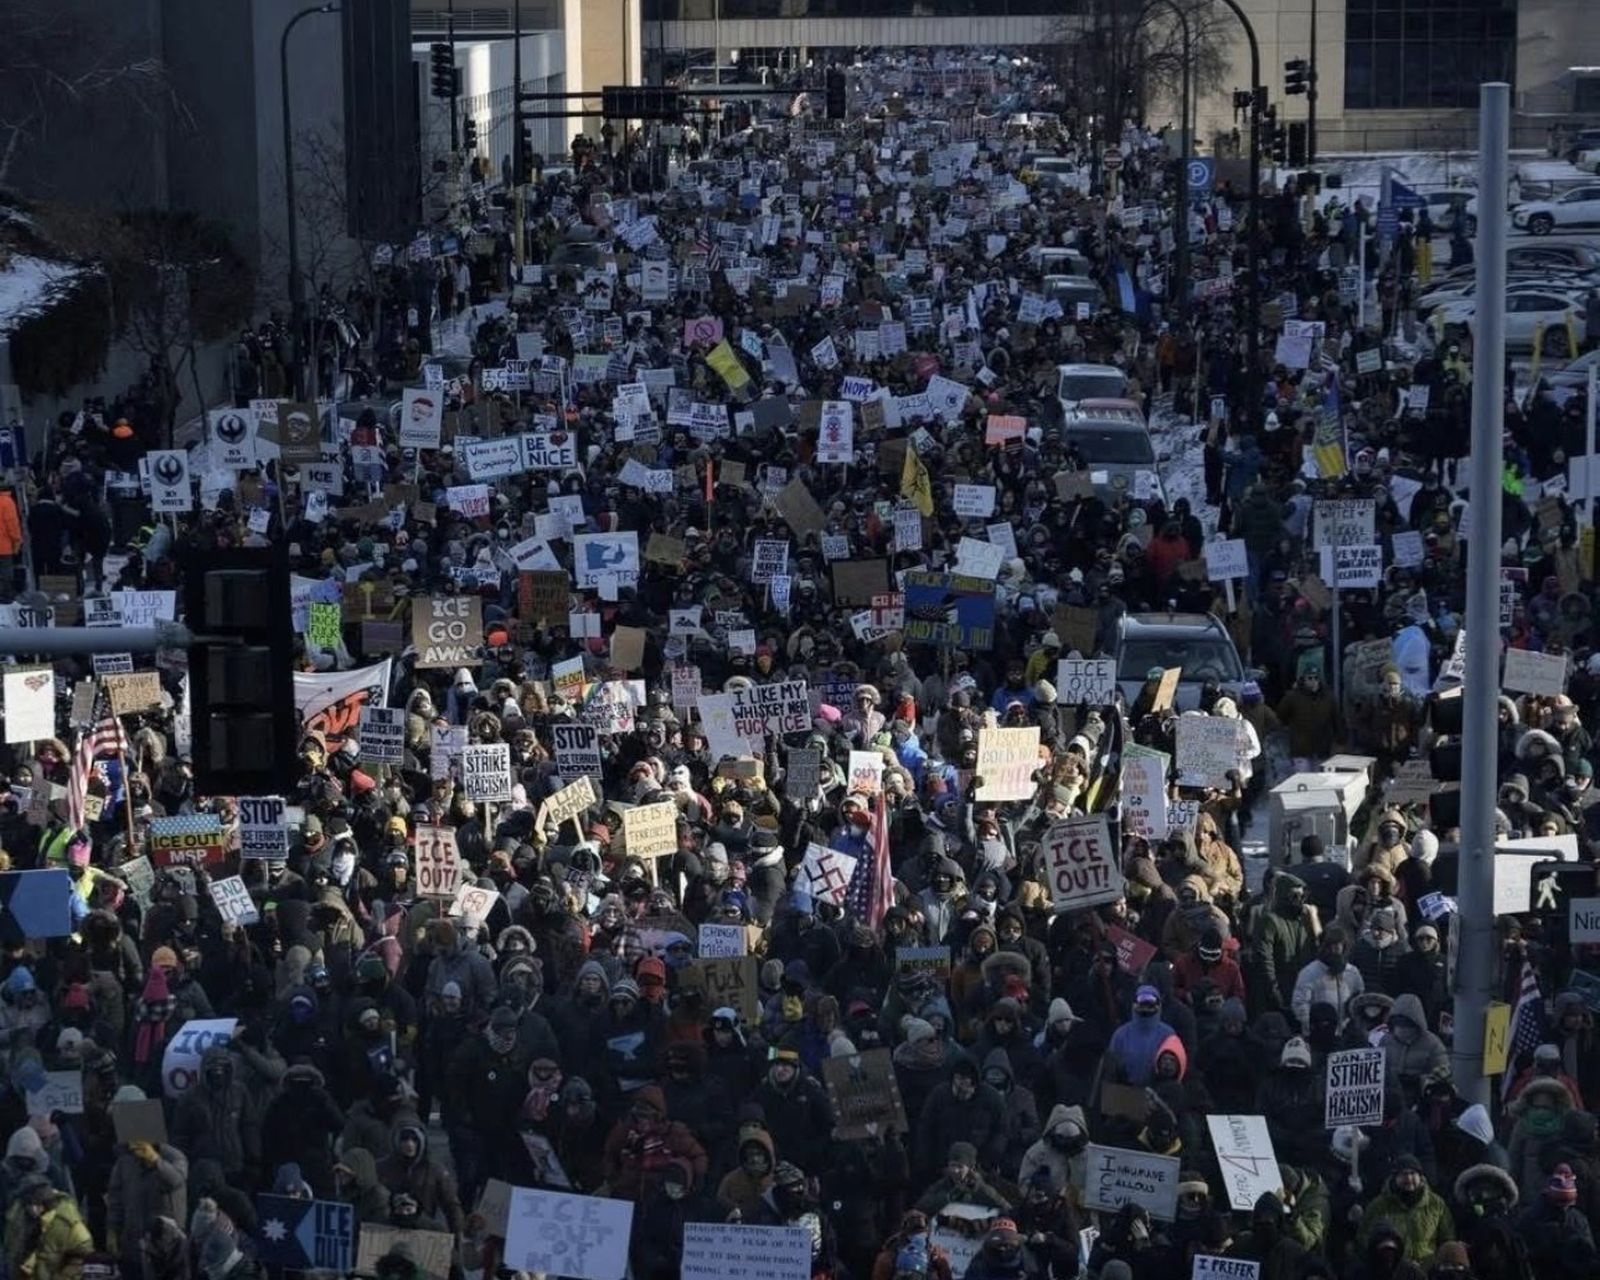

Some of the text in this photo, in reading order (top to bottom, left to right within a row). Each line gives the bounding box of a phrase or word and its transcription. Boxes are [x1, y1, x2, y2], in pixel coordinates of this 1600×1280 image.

[843, 381, 871, 397] NOPE
[526, 438, 543, 450] BE
[530, 450, 573, 466] NICE
[309, 471, 331, 482] ICE
[432, 599, 470, 617] ICE
[429, 620, 467, 643] GO
[1068, 661, 1107, 677] ICE
[735, 683, 803, 705] I LIKE MY
[1071, 678, 1107, 690] OUT
[732, 702, 785, 718] WHISKEY
[735, 715, 805, 736] FUCK ICE
[555, 727, 595, 748] STOP
[467, 756, 507, 773] STRIKE
[466, 779, 508, 794] RACISM
[240, 801, 284, 825] STOP
[628, 811, 650, 826] ICE
[651, 808, 661, 821] IS
[1170, 801, 1194, 813] ICE
[1168, 814, 1195, 827] OUT
[154, 833, 221, 848] ICE OUT
[256, 831, 285, 842] TERROR
[170, 849, 207, 863] MSP
[418, 841, 452, 865] ICE
[1050, 840, 1102, 868] ICE
[419, 867, 457, 891] OUT!
[1057, 865, 1110, 894] OUT!
[211, 879, 243, 904] END
[216, 896, 255, 922] ICE
[1330, 1061, 1380, 1088] STRIKE
[1328, 1092, 1381, 1118] RACISM
[315, 1203, 352, 1235] ICE
[522, 1195, 603, 1224] ICE
[541, 1222, 616, 1246] OUT
[315, 1236, 352, 1272] OUT
[551, 1238, 595, 1258] OF
[1199, 1258, 1254, 1278] I PREFER
